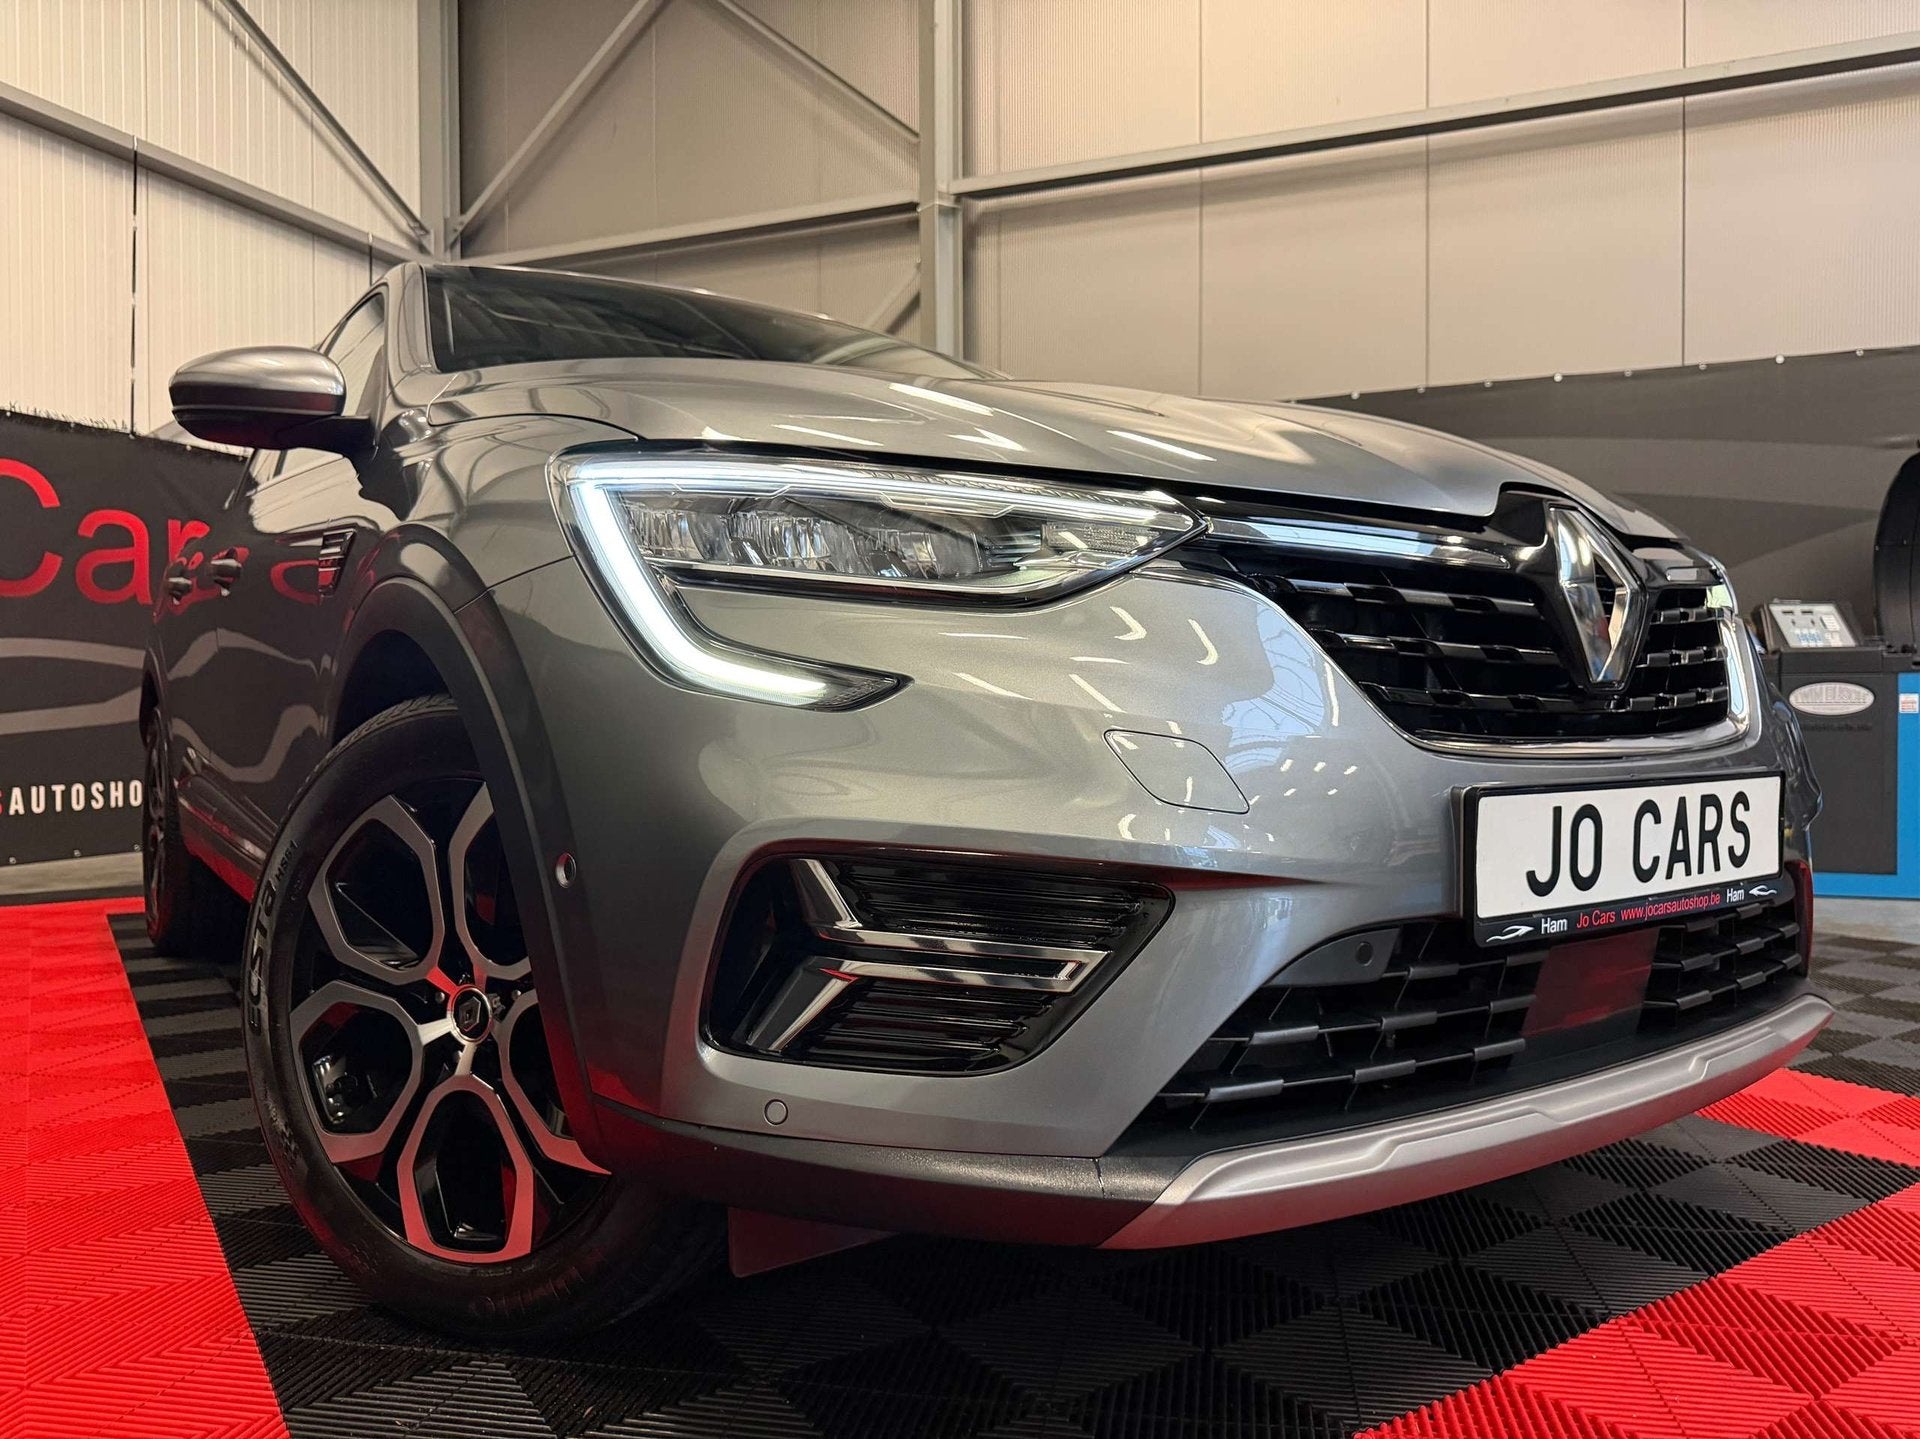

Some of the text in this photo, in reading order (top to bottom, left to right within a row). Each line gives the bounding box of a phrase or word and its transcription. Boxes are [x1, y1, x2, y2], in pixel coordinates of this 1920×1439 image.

[1526, 791, 1751, 897] JO CARS
[1541, 887, 1745, 934] Ham Jo Cars www.jocarsautoshop.be Ham
